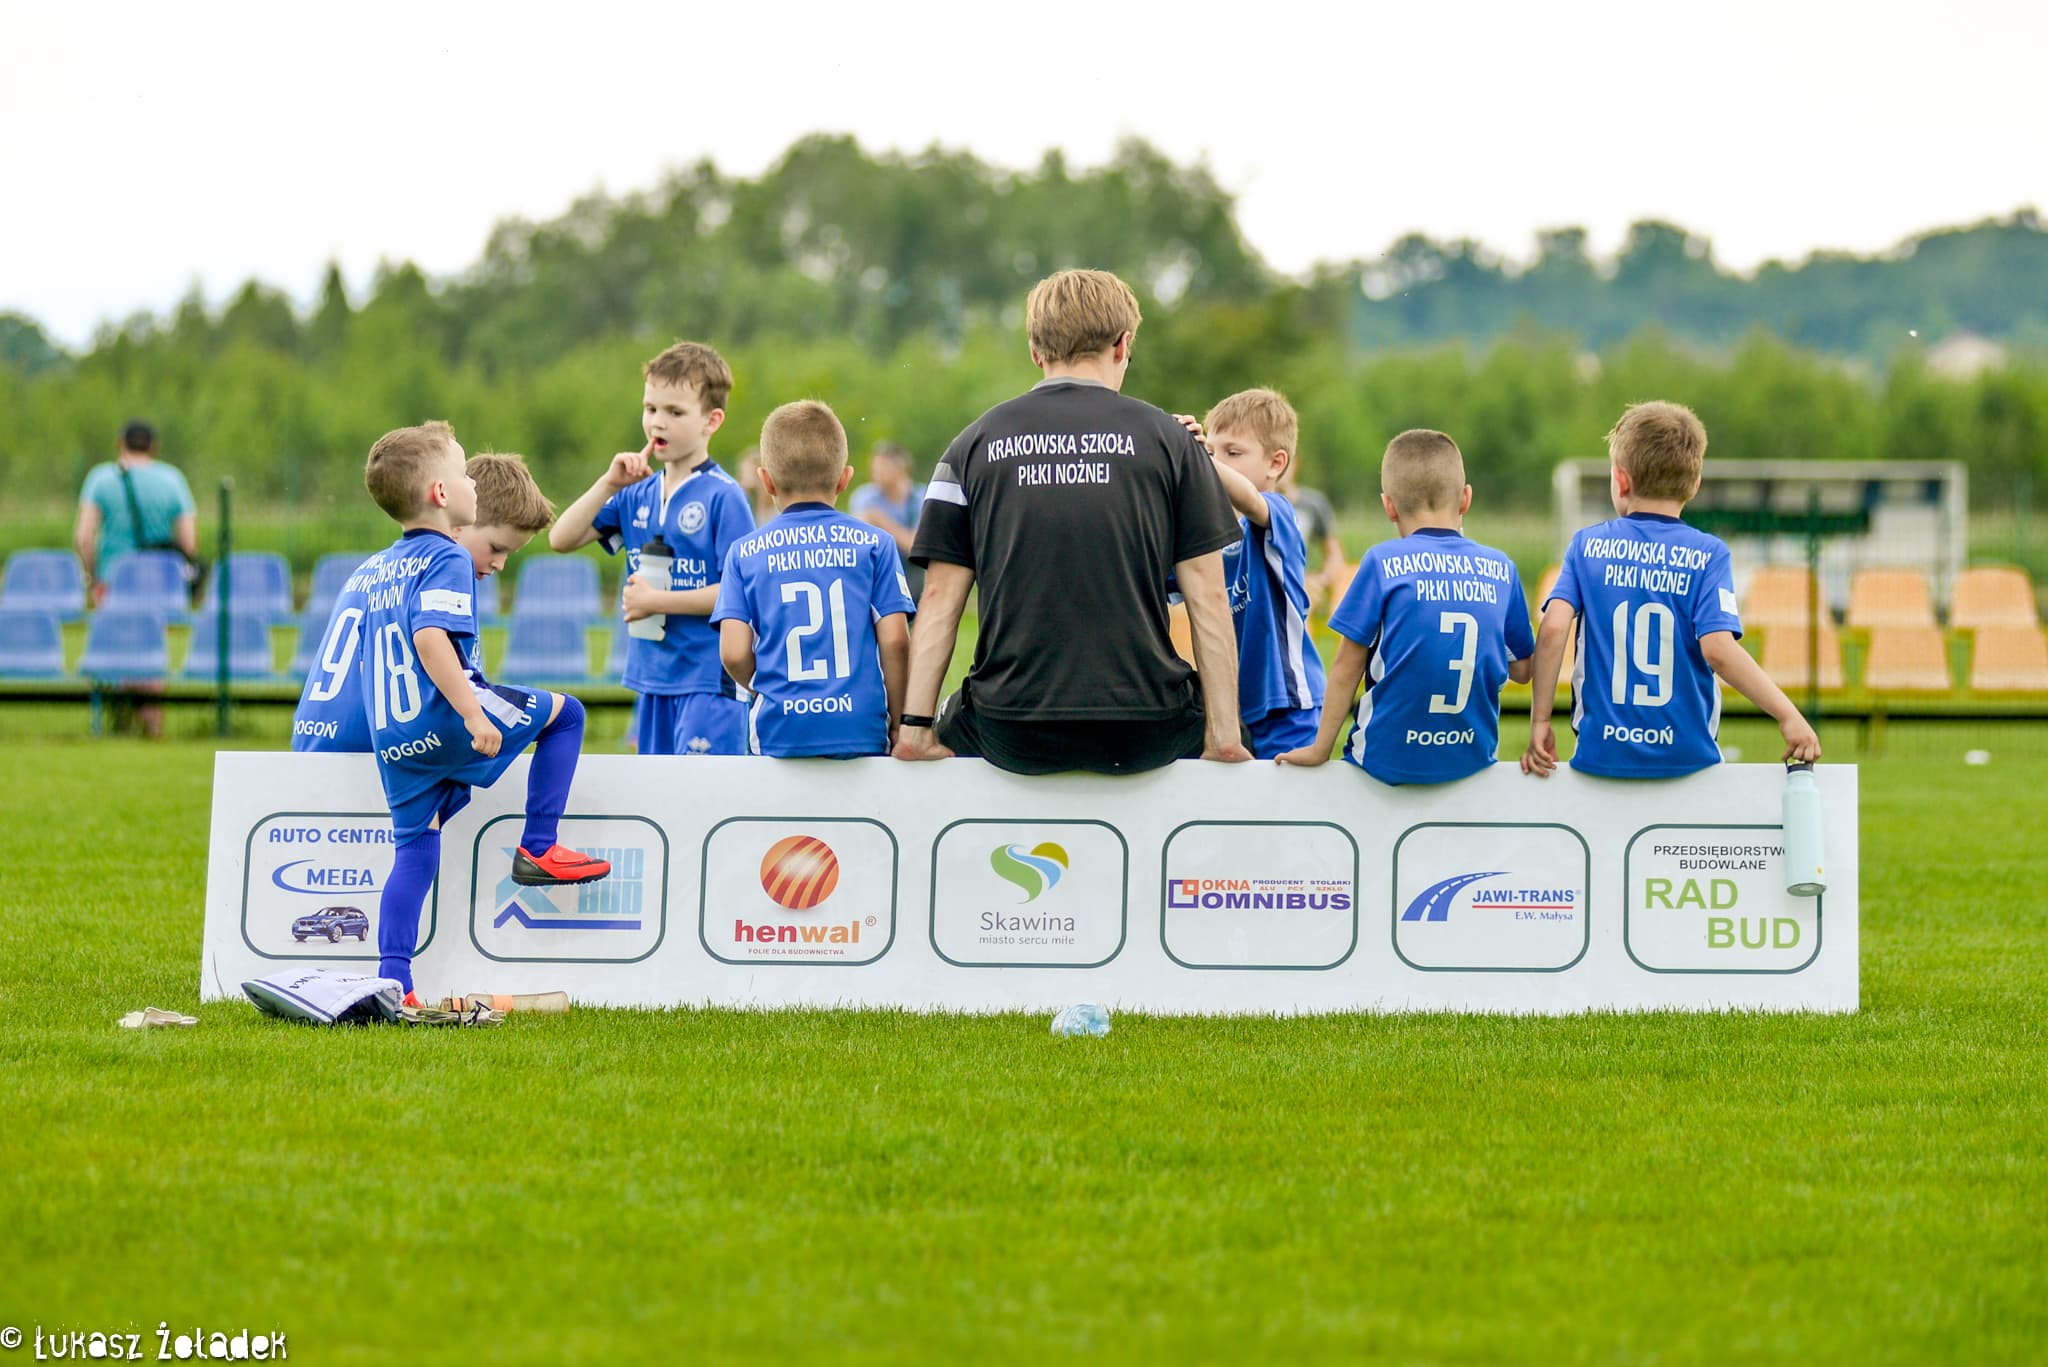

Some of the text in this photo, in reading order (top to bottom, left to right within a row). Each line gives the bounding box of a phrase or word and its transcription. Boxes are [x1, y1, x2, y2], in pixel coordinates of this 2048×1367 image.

[988, 433, 1135, 463] KRAKOWSKA SZKOŁA
[1018, 458, 1110, 486] PIŁKI NOŻNEJ
[739, 525, 879, 558] KRAKOWSKA SZKOŁA
[1584, 538, 1711, 571] KRAKOWSKA SZKO
[767, 544, 857, 573] PIŁKI NOŻNEJ
[1382, 552, 1510, 584] KRAKOWSKA SZKOŁA
[1417, 576, 1497, 604] PIŁKI NOŻNEJ
[1604, 564, 1691, 596] PIŁKI NOŻNEJ
[780, 577, 851, 682] 21
[308, 607, 364, 701] 9
[1428, 611, 1478, 714] 3
[1612, 600, 1675, 707] 19
[374, 621, 422, 730] 18
[783, 693, 852, 715] POGOŃ
[380, 731, 441, 764] POGOŃ
[1406, 728, 1475, 745] POGOŃ
[1603, 724, 1673, 745] POGOŃ
[269, 828, 395, 843] AUTO CENTRU
[1654, 845, 1785, 858] PRZEDSIĘBIORSTW
[1679, 860, 1767, 870] BUDOWLANE
[306, 868, 374, 886] MEGA
[1202, 880, 1250, 891] OKNA
[1201, 892, 1351, 911] OMNIBUS
[1472, 890, 1574, 903] JAWI-TRANS
[1645, 878, 1738, 909] RAD
[980, 911, 1075, 932] Skawina
[1515, 911, 1536, 921] E.W.
[734, 919, 860, 943] henwal
[979, 934, 1015, 945] miasto
[1018, 936, 1048, 945] sercu
[1707, 917, 1800, 949] BUD
